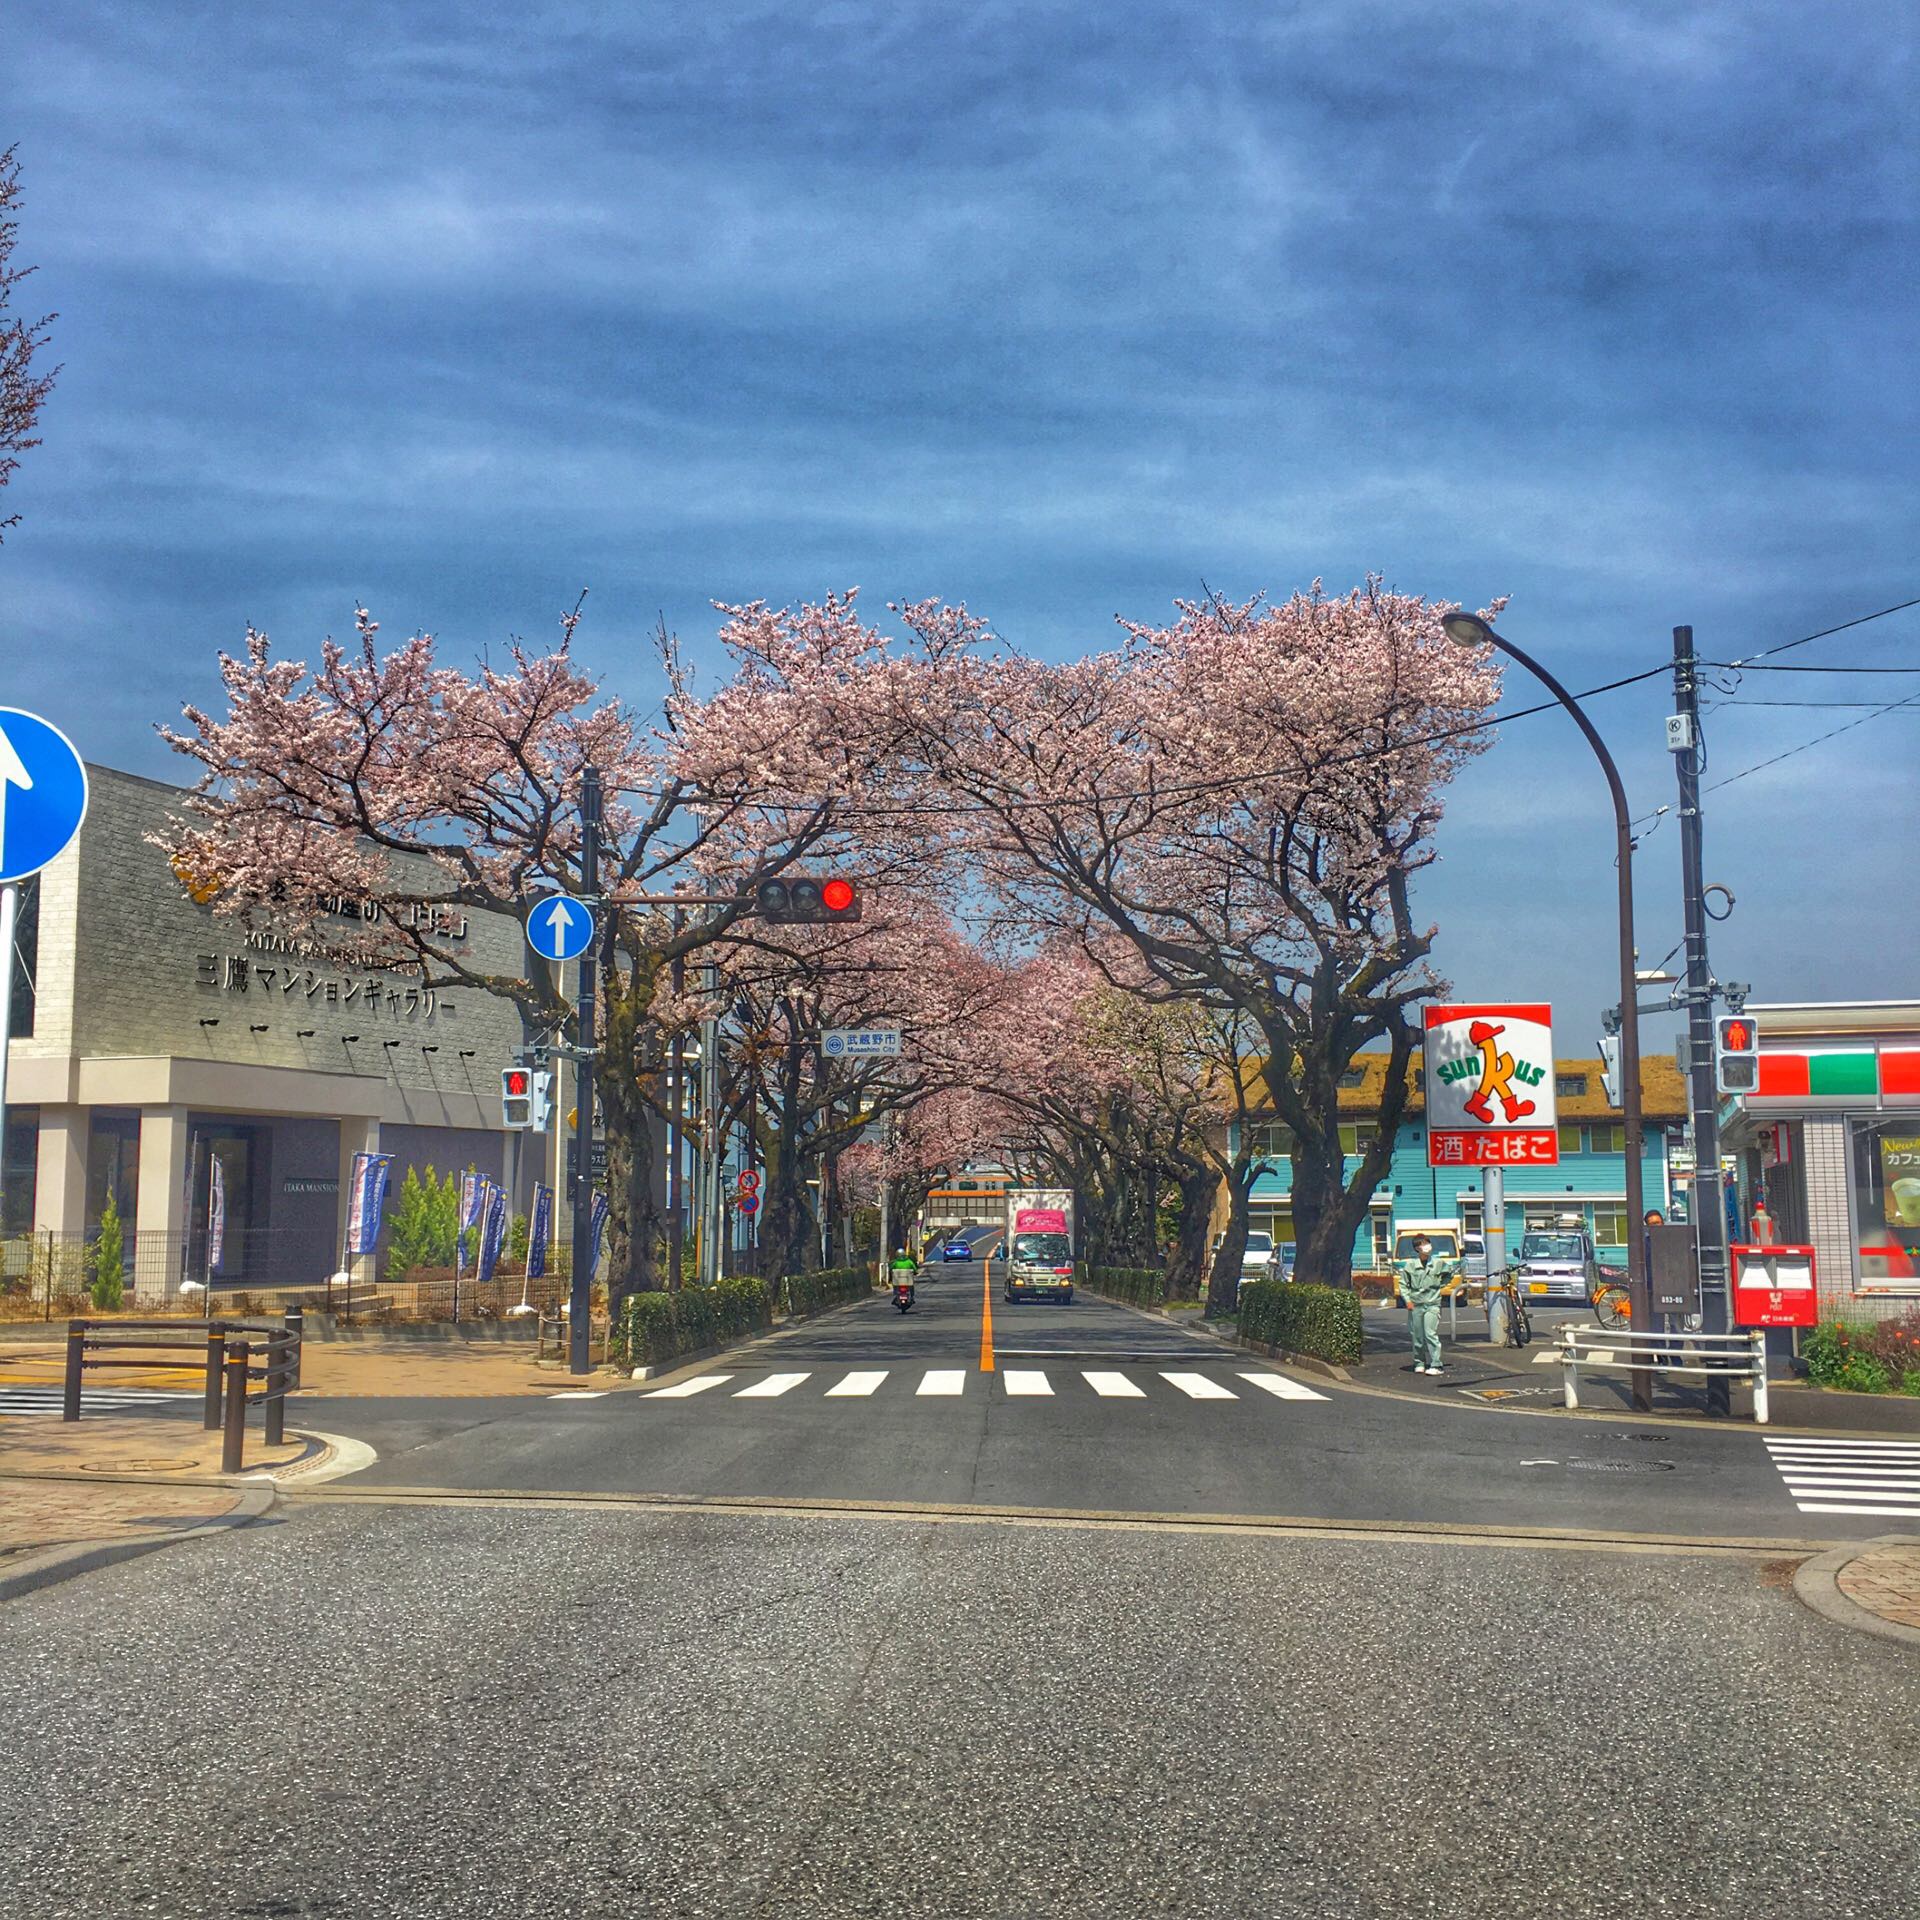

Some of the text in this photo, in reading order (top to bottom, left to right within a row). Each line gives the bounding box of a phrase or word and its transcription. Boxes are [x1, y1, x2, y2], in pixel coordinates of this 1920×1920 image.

[195, 953, 457, 1018] 三鷹マンションギャラリー
[847, 1034, 896, 1045] 武蔵野市
[1436, 1134, 1552, 1161] 酒・たばこ
